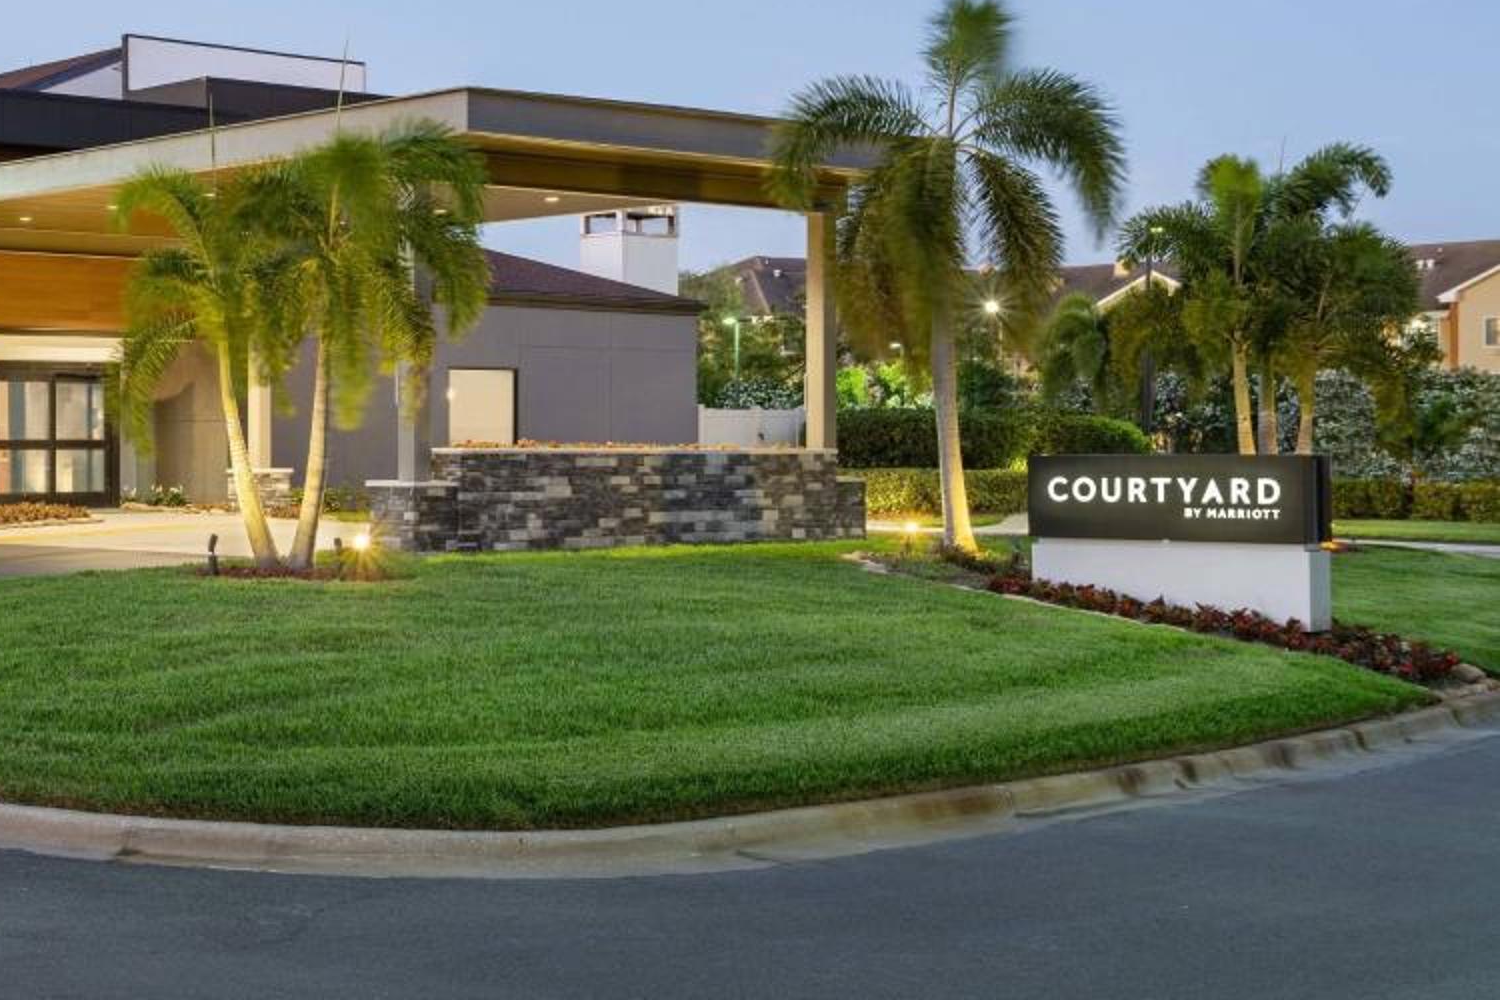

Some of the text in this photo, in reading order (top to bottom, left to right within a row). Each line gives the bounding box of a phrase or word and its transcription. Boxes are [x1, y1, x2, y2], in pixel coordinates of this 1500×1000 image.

[1047, 476, 1281, 505] COURTYARD
[1183, 507, 1281, 520] BY MARRIOTT
